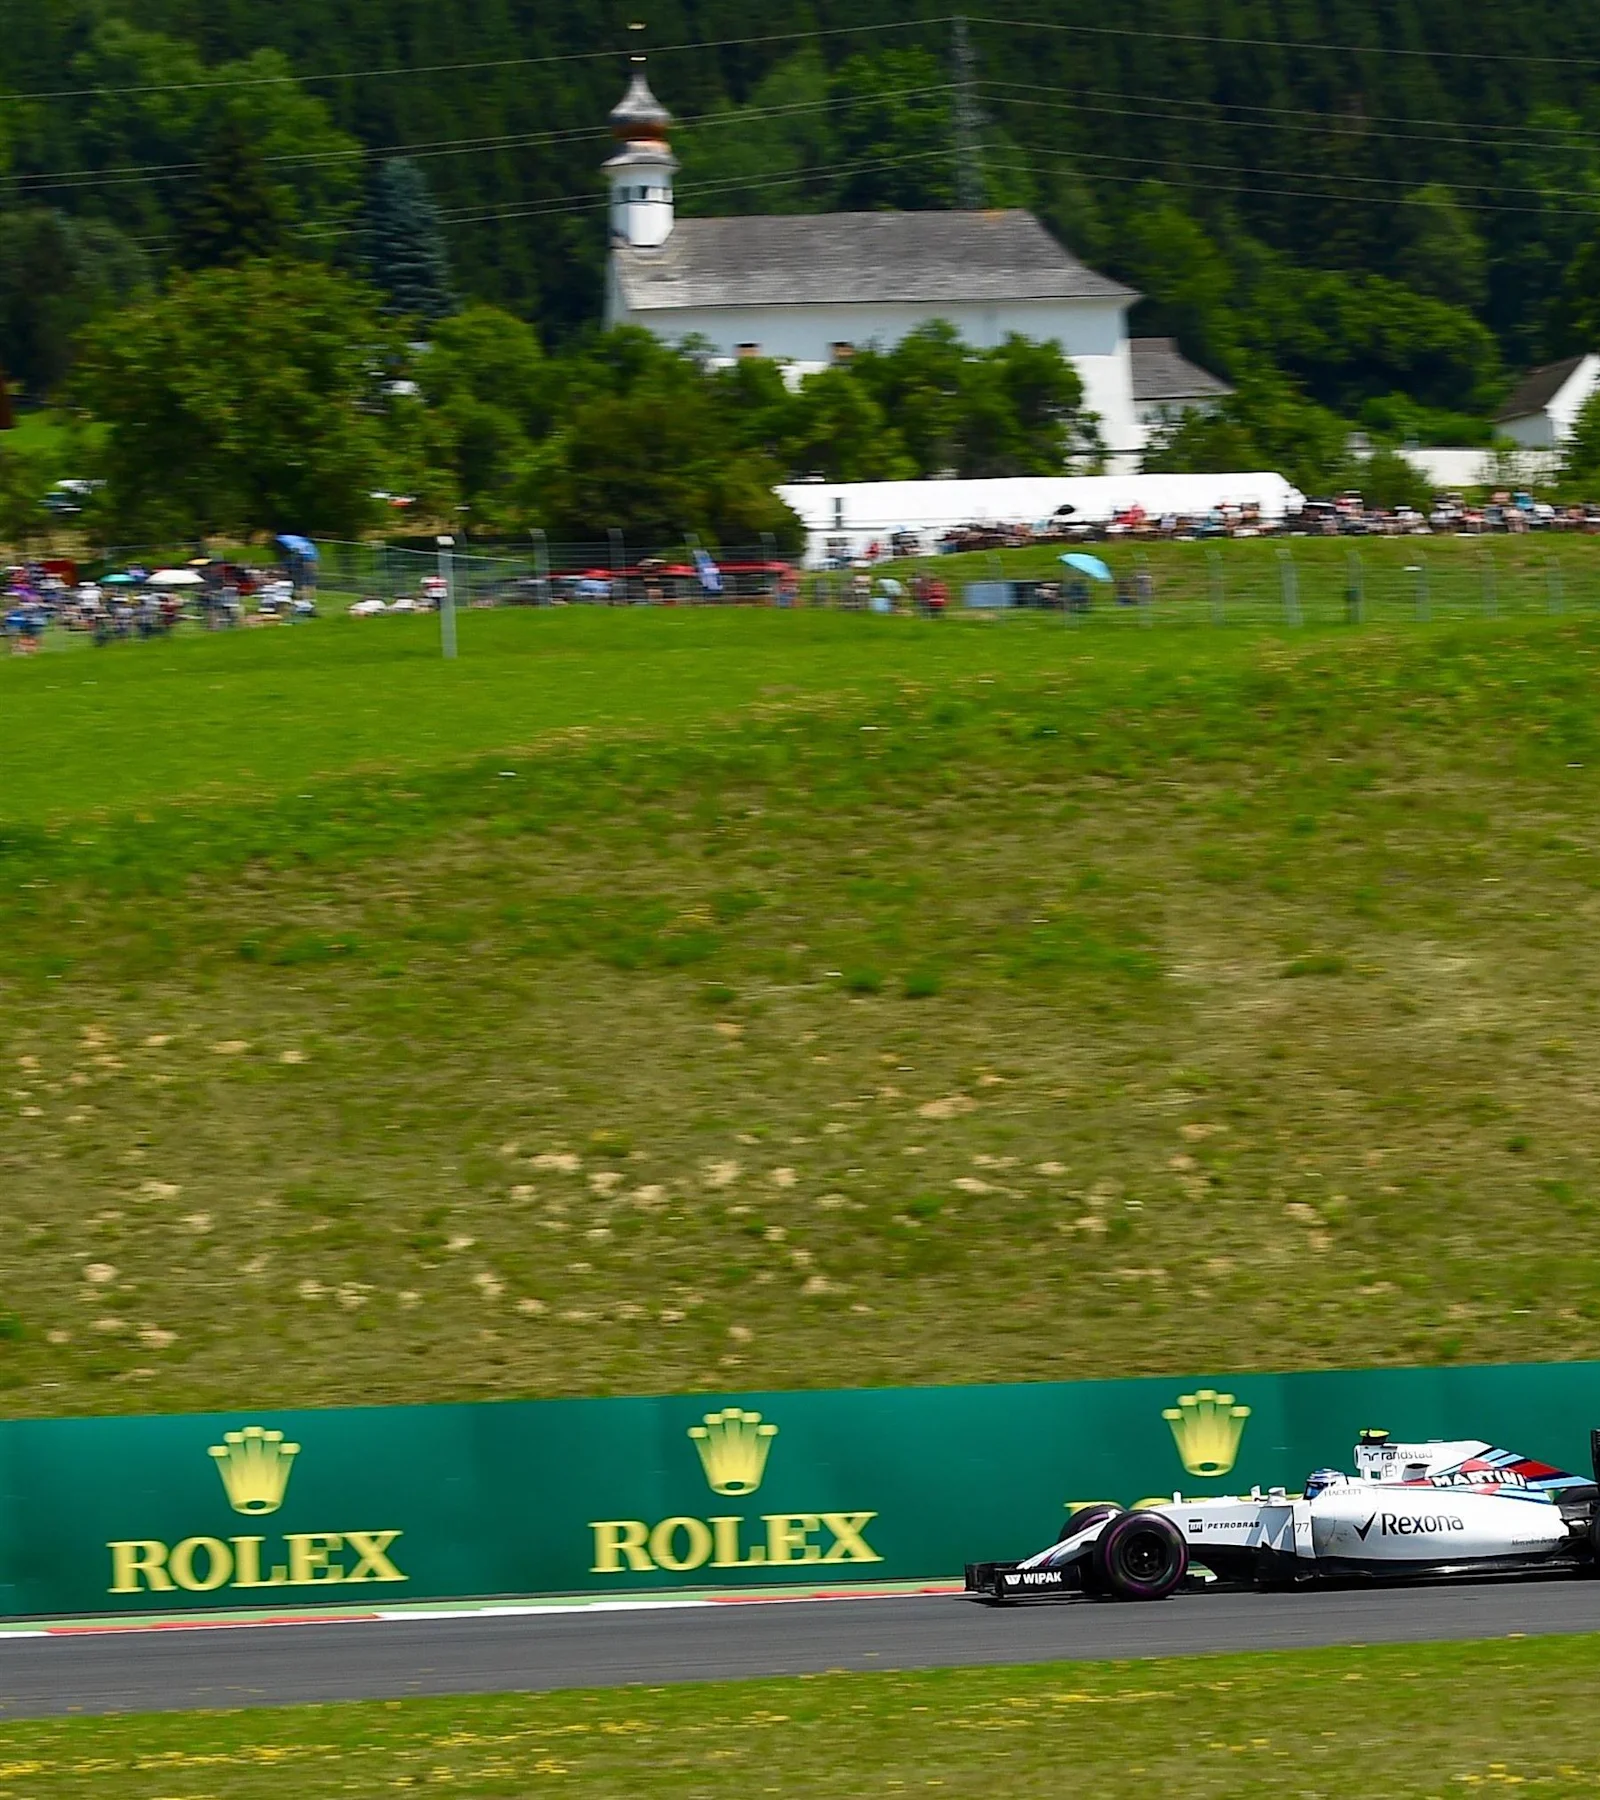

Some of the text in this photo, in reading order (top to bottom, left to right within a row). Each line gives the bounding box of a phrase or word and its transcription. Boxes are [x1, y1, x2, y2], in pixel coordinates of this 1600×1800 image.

[1381, 1448, 1433, 1461] randstad
[1432, 1470, 1526, 1488] MARTINI
[1207, 1521, 1260, 1530] PETROBRAS
[1296, 1522, 1309, 1533] 77
[1381, 1513, 1464, 1535] Rexona
[587, 1511, 885, 1573] ROLEX
[105, 1530, 410, 1593] ROLEX
[1023, 1571, 1062, 1585] WIPAK
